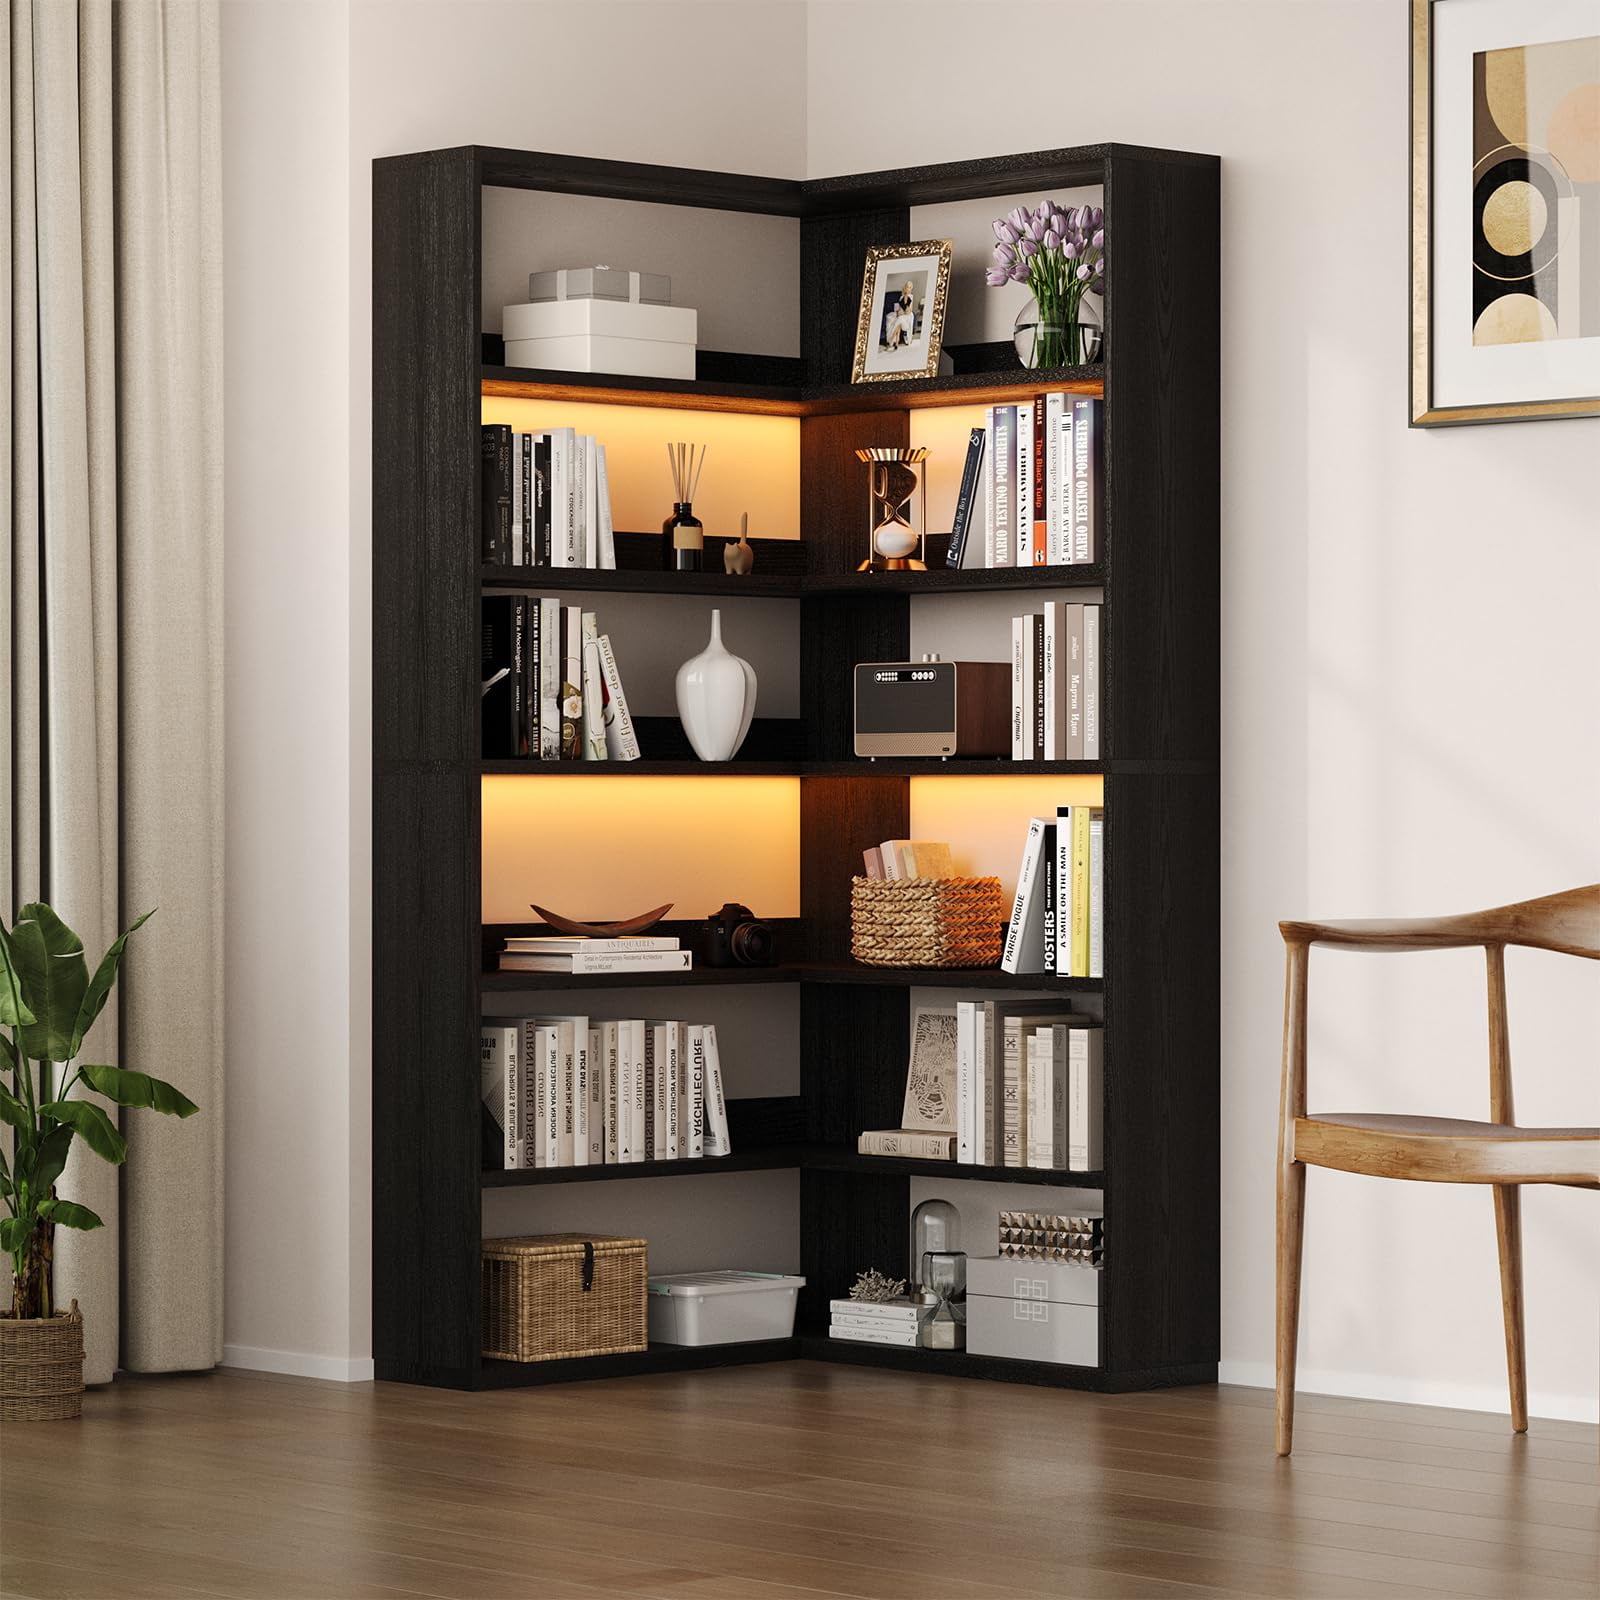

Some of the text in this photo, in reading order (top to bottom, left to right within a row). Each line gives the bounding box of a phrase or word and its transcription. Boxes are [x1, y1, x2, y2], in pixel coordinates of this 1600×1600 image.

[996, 425, 1008, 563] MARIO TESTINO PORTREITS
[1035, 484, 1043, 508] Tulip
[1076, 419, 1088, 559] MARIO TESTINO PORTREITS
[951, 524, 961, 550] Outside
[600, 638, 631, 736] flower designer
[1070, 675, 1079, 737] Мартин Иден
[1087, 692, 1095, 742] ТРАКТАТЫ
[1005, 893, 1025, 962] PARISE VOGUE
[1060, 892, 1067, 907] ON
[607, 940, 655, 949] ANTIQUAIRES
[1044, 911, 1055, 970] POSTERS
